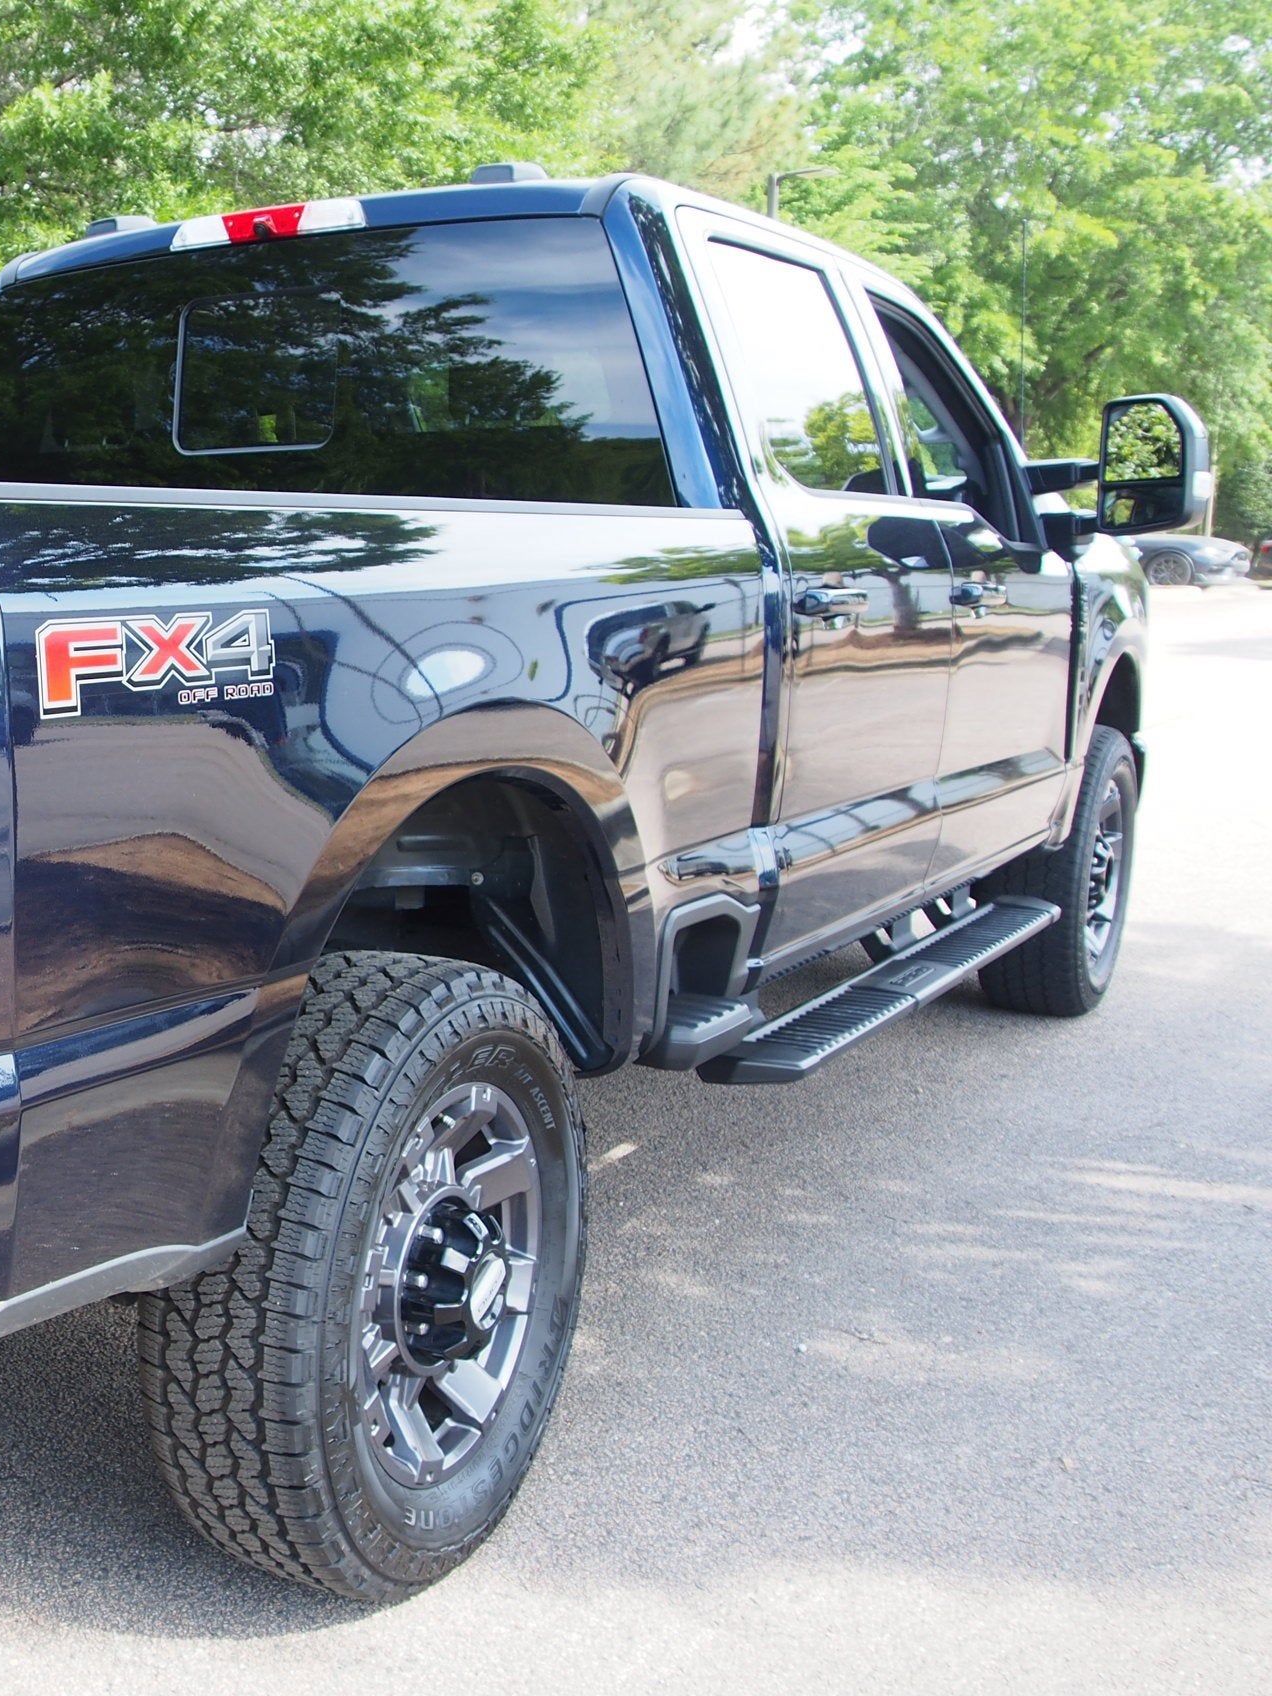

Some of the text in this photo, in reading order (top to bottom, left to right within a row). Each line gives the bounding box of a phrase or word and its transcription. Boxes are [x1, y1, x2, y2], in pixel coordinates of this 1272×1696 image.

[35, 608, 277, 720] FX4
[178, 682, 275, 705] OFF ROAD
[529, 1086, 557, 1129] ASCENT
